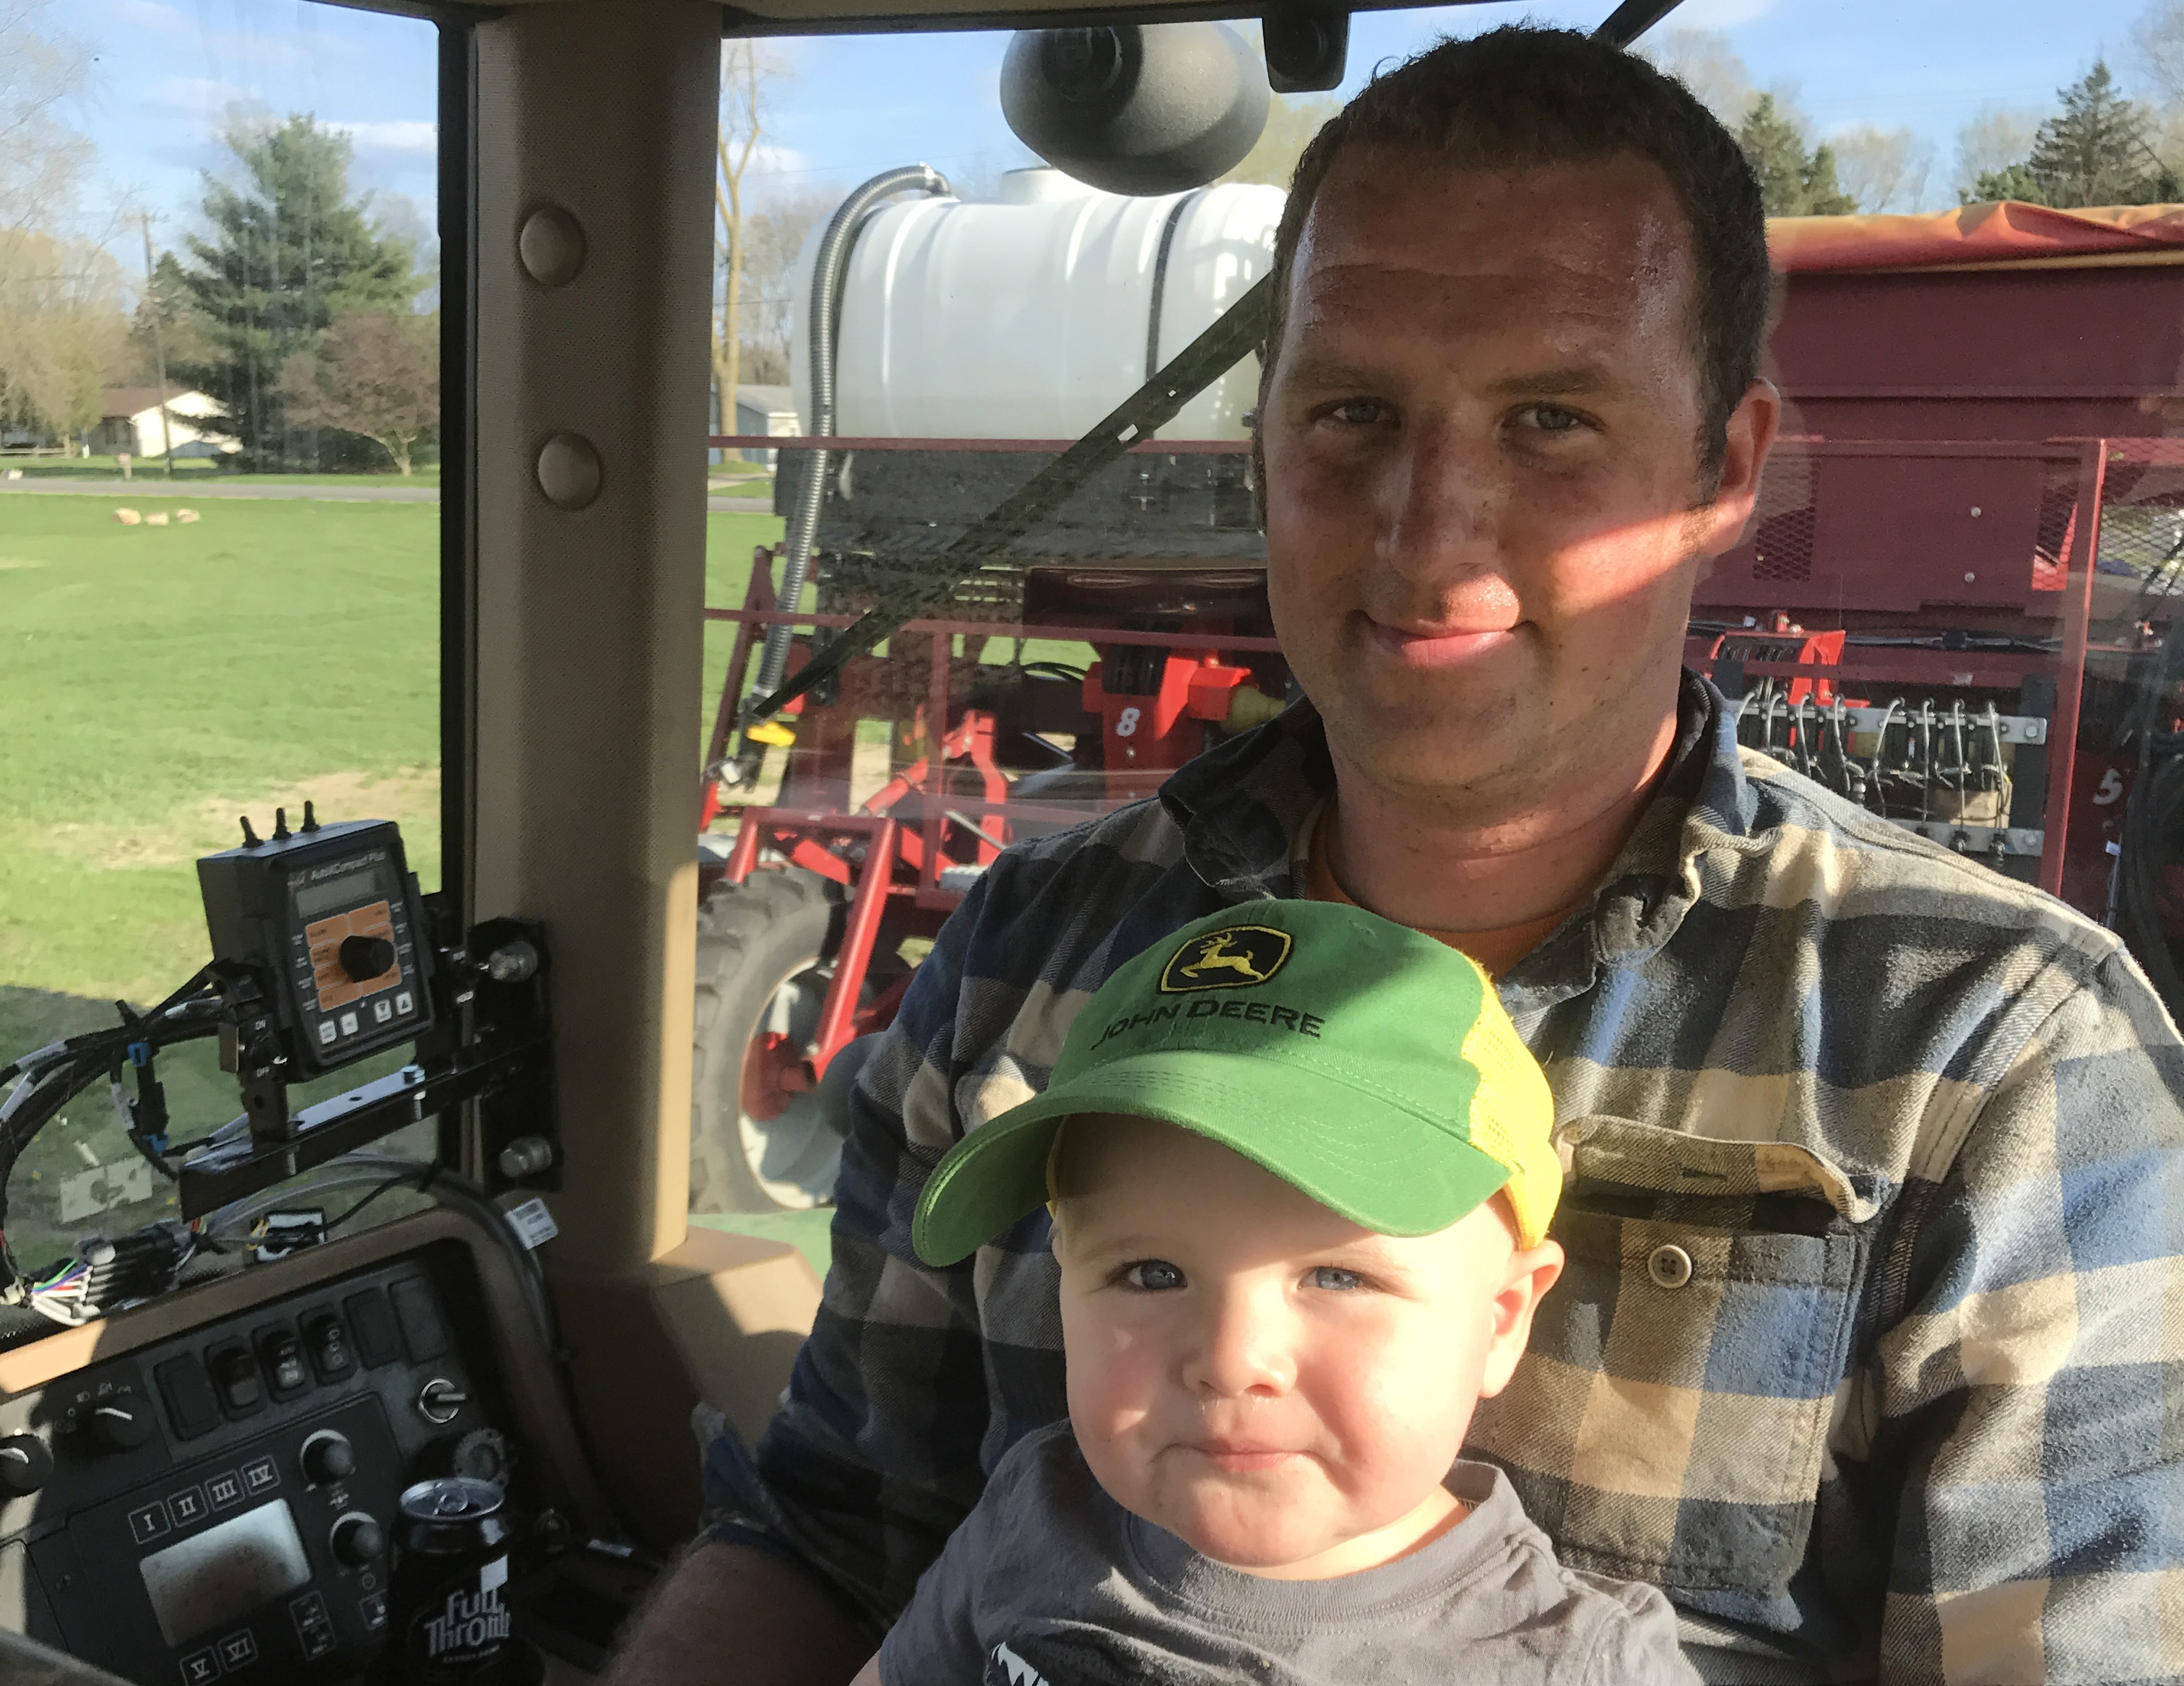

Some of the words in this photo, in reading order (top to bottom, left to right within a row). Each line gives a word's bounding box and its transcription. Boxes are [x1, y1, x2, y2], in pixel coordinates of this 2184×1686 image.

[1115, 706, 1141, 738] 8
[2092, 767, 2124, 805] 5
[1090, 1003, 1182, 1051] JOHN
[1185, 998, 1327, 1039] DEERE
[247, 1464, 274, 1487] IV
[211, 1478, 238, 1503] III
[178, 1495, 197, 1518] II
